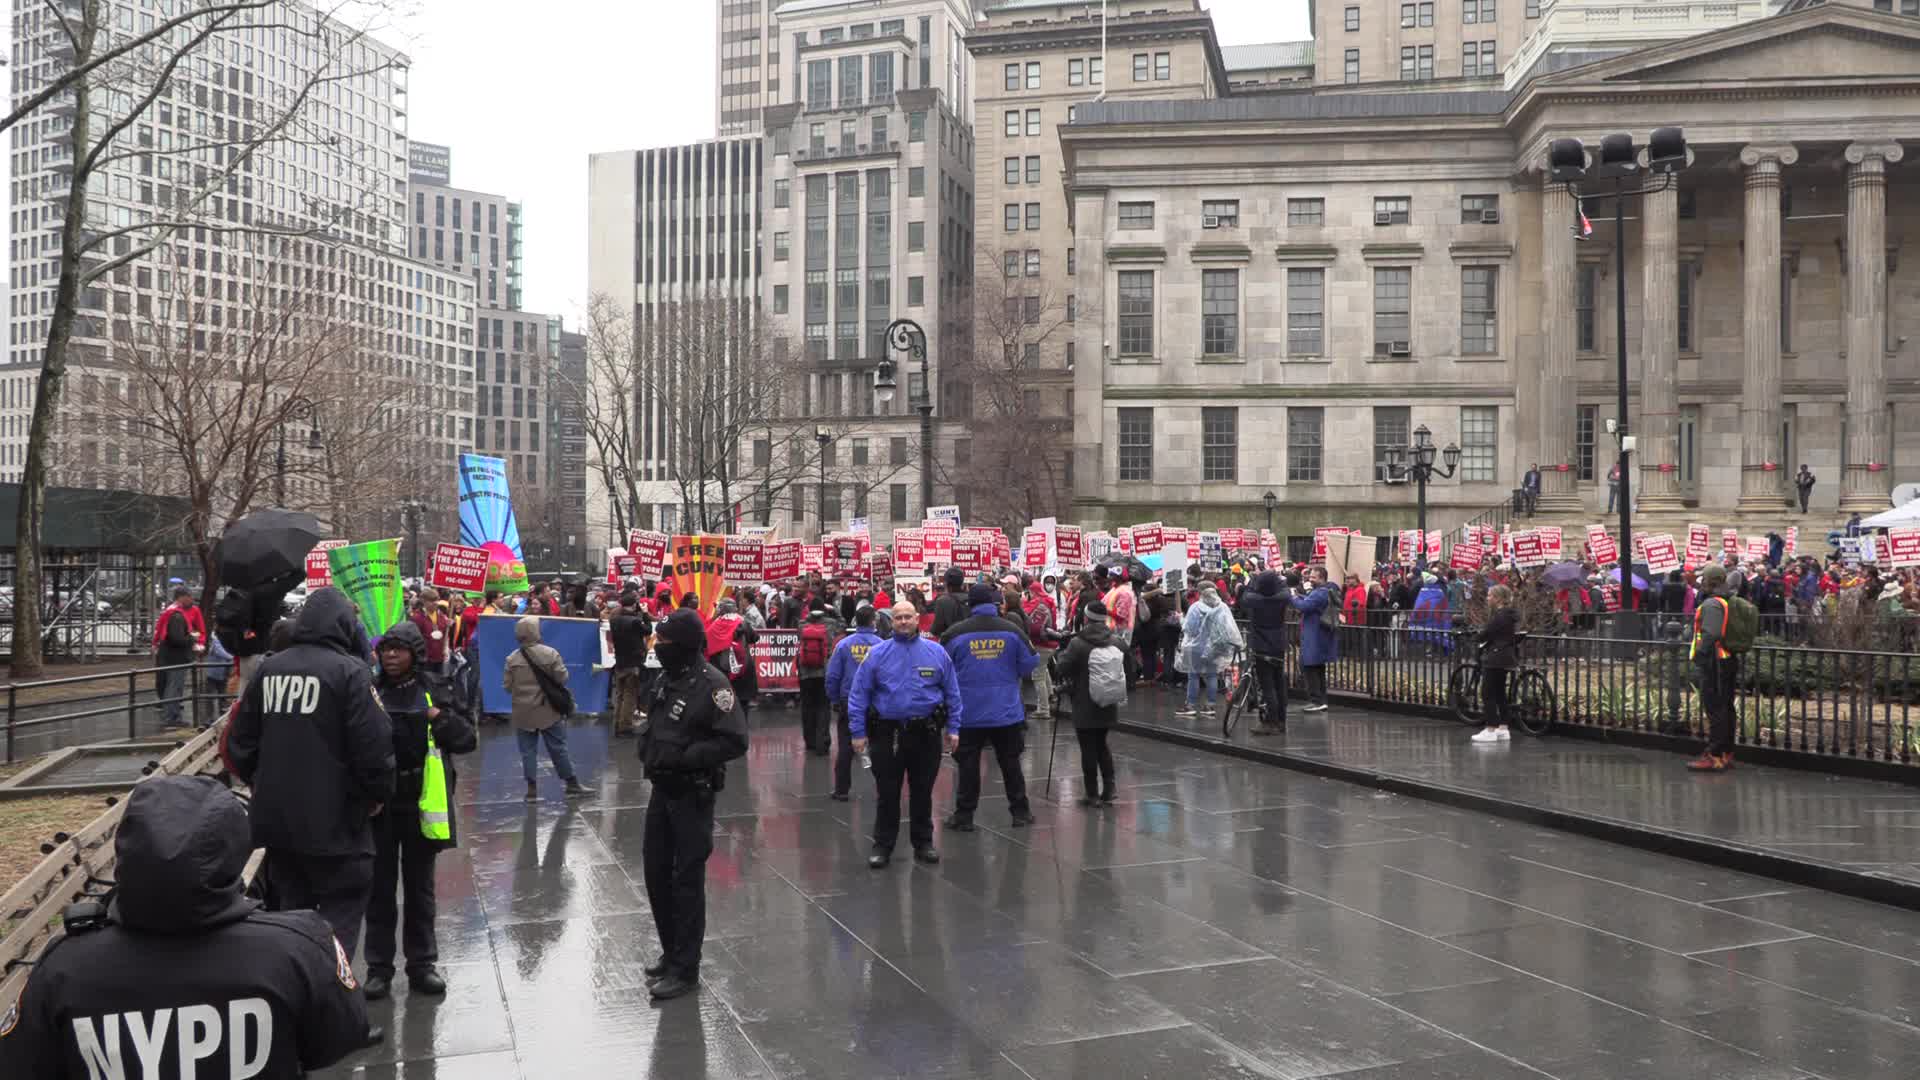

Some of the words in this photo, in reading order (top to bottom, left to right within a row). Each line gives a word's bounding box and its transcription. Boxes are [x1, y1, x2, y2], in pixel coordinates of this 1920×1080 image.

[1139, 536, 1157, 544] CUNY
[440, 546, 460, 556] FUND
[635, 546, 658, 557] CUNY
[677, 544, 724, 558] FREE
[437, 555, 451, 564] THE
[452, 557, 487, 570] PEOPLE'S
[732, 554, 756, 562] CUNY
[439, 563, 482, 577] UNIVERSITY
[777, 634, 800, 645] OPPO
[969, 639, 1006, 649] NYPD
[750, 647, 786, 657] CONOMIC
[759, 662, 793, 677] SUNY
[263, 675, 320, 714] NYPD
[72, 998, 272, 1080] NYPD
